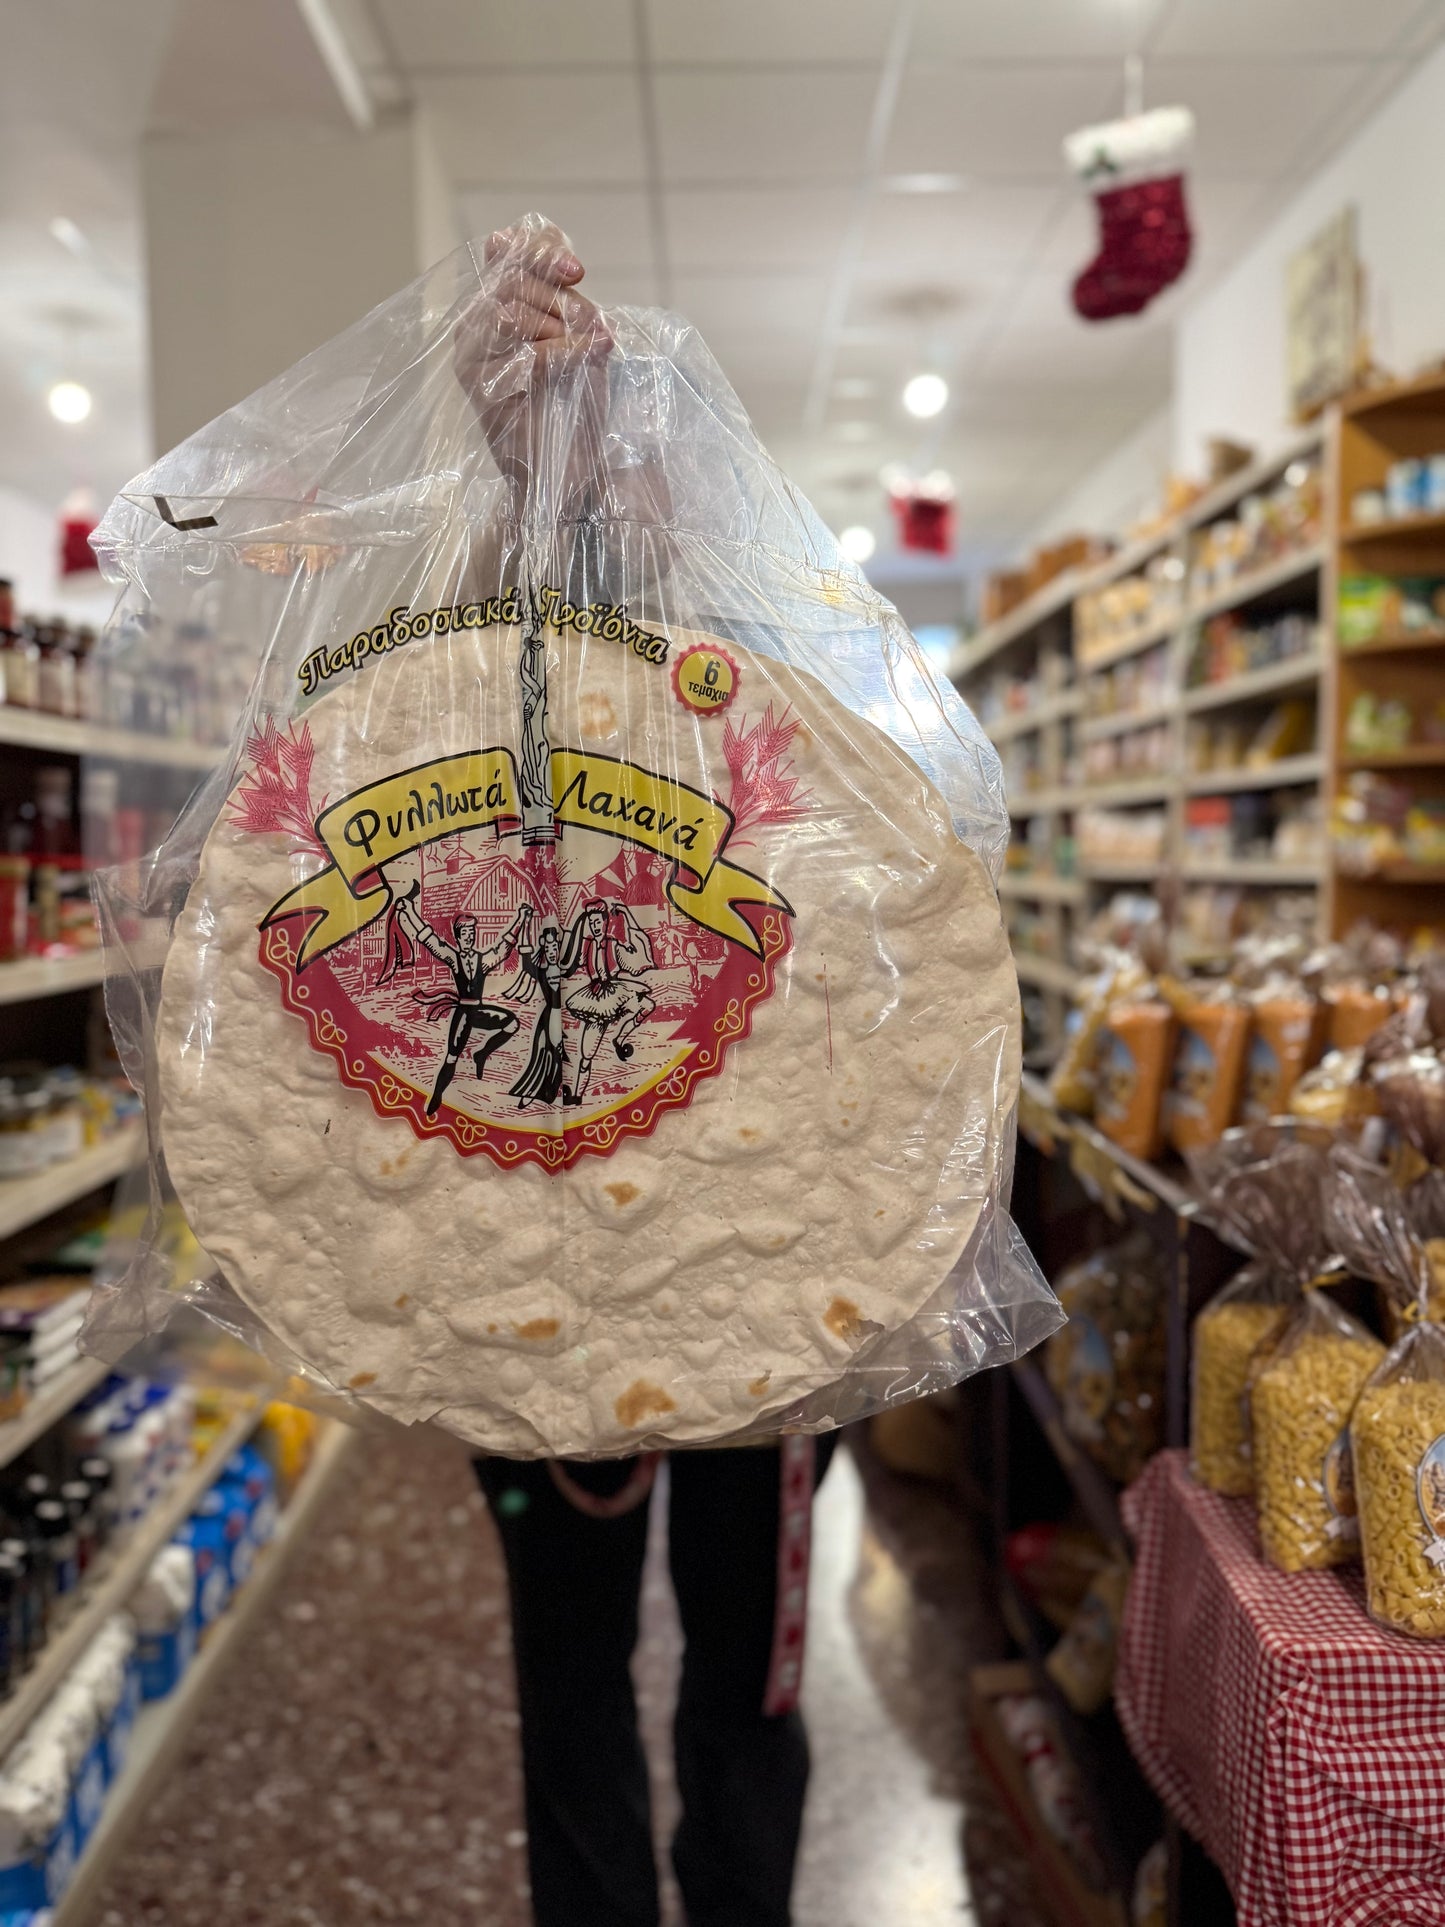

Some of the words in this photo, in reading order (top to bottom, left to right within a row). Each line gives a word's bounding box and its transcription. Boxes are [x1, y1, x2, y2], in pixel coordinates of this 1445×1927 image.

[296, 585, 523, 696] Παραδοσιακά
[539, 584, 672, 665] Προϊόντα
[704, 660, 721, 686] 6
[343, 768, 507, 858] Φυλλωτά
[552, 770, 704, 851] Λαχανά
